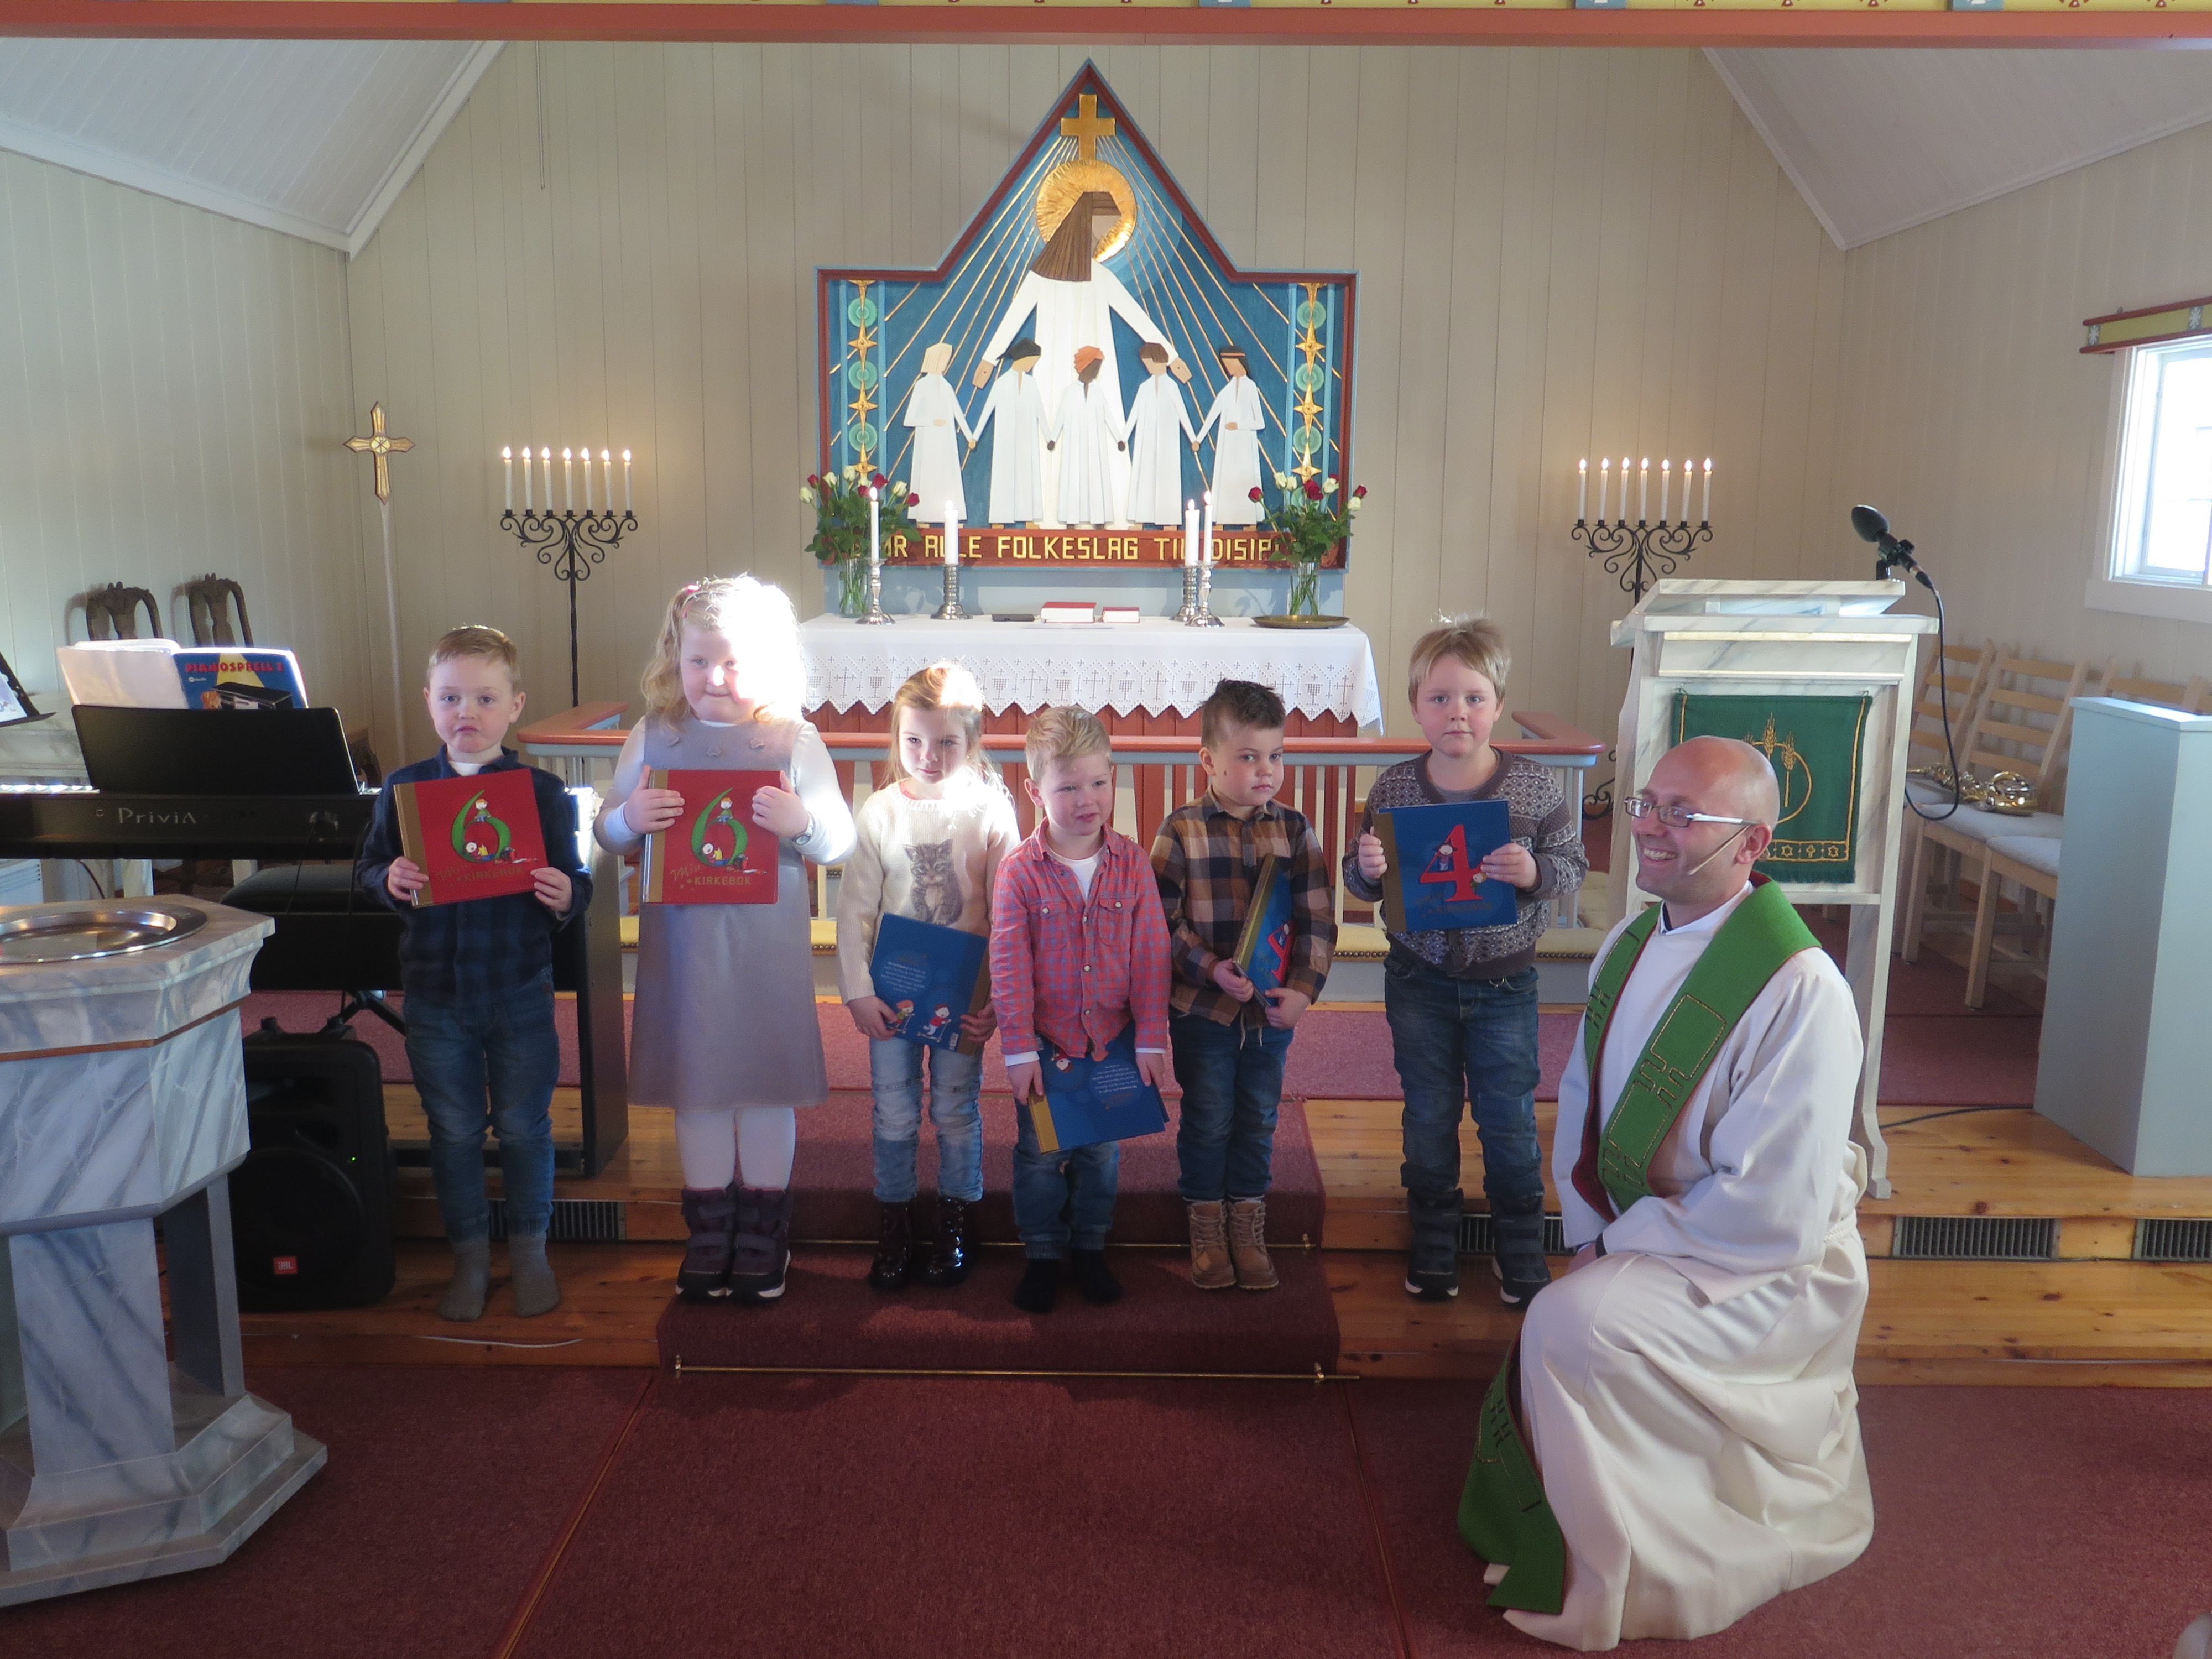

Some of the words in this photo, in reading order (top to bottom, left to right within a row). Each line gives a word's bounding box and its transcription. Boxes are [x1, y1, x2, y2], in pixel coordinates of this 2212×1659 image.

[998, 536, 1138, 560] FOLKESLAG
[695, 875, 752, 885] KIRKEBOK
[278, 1261, 294, 1270] JBL
